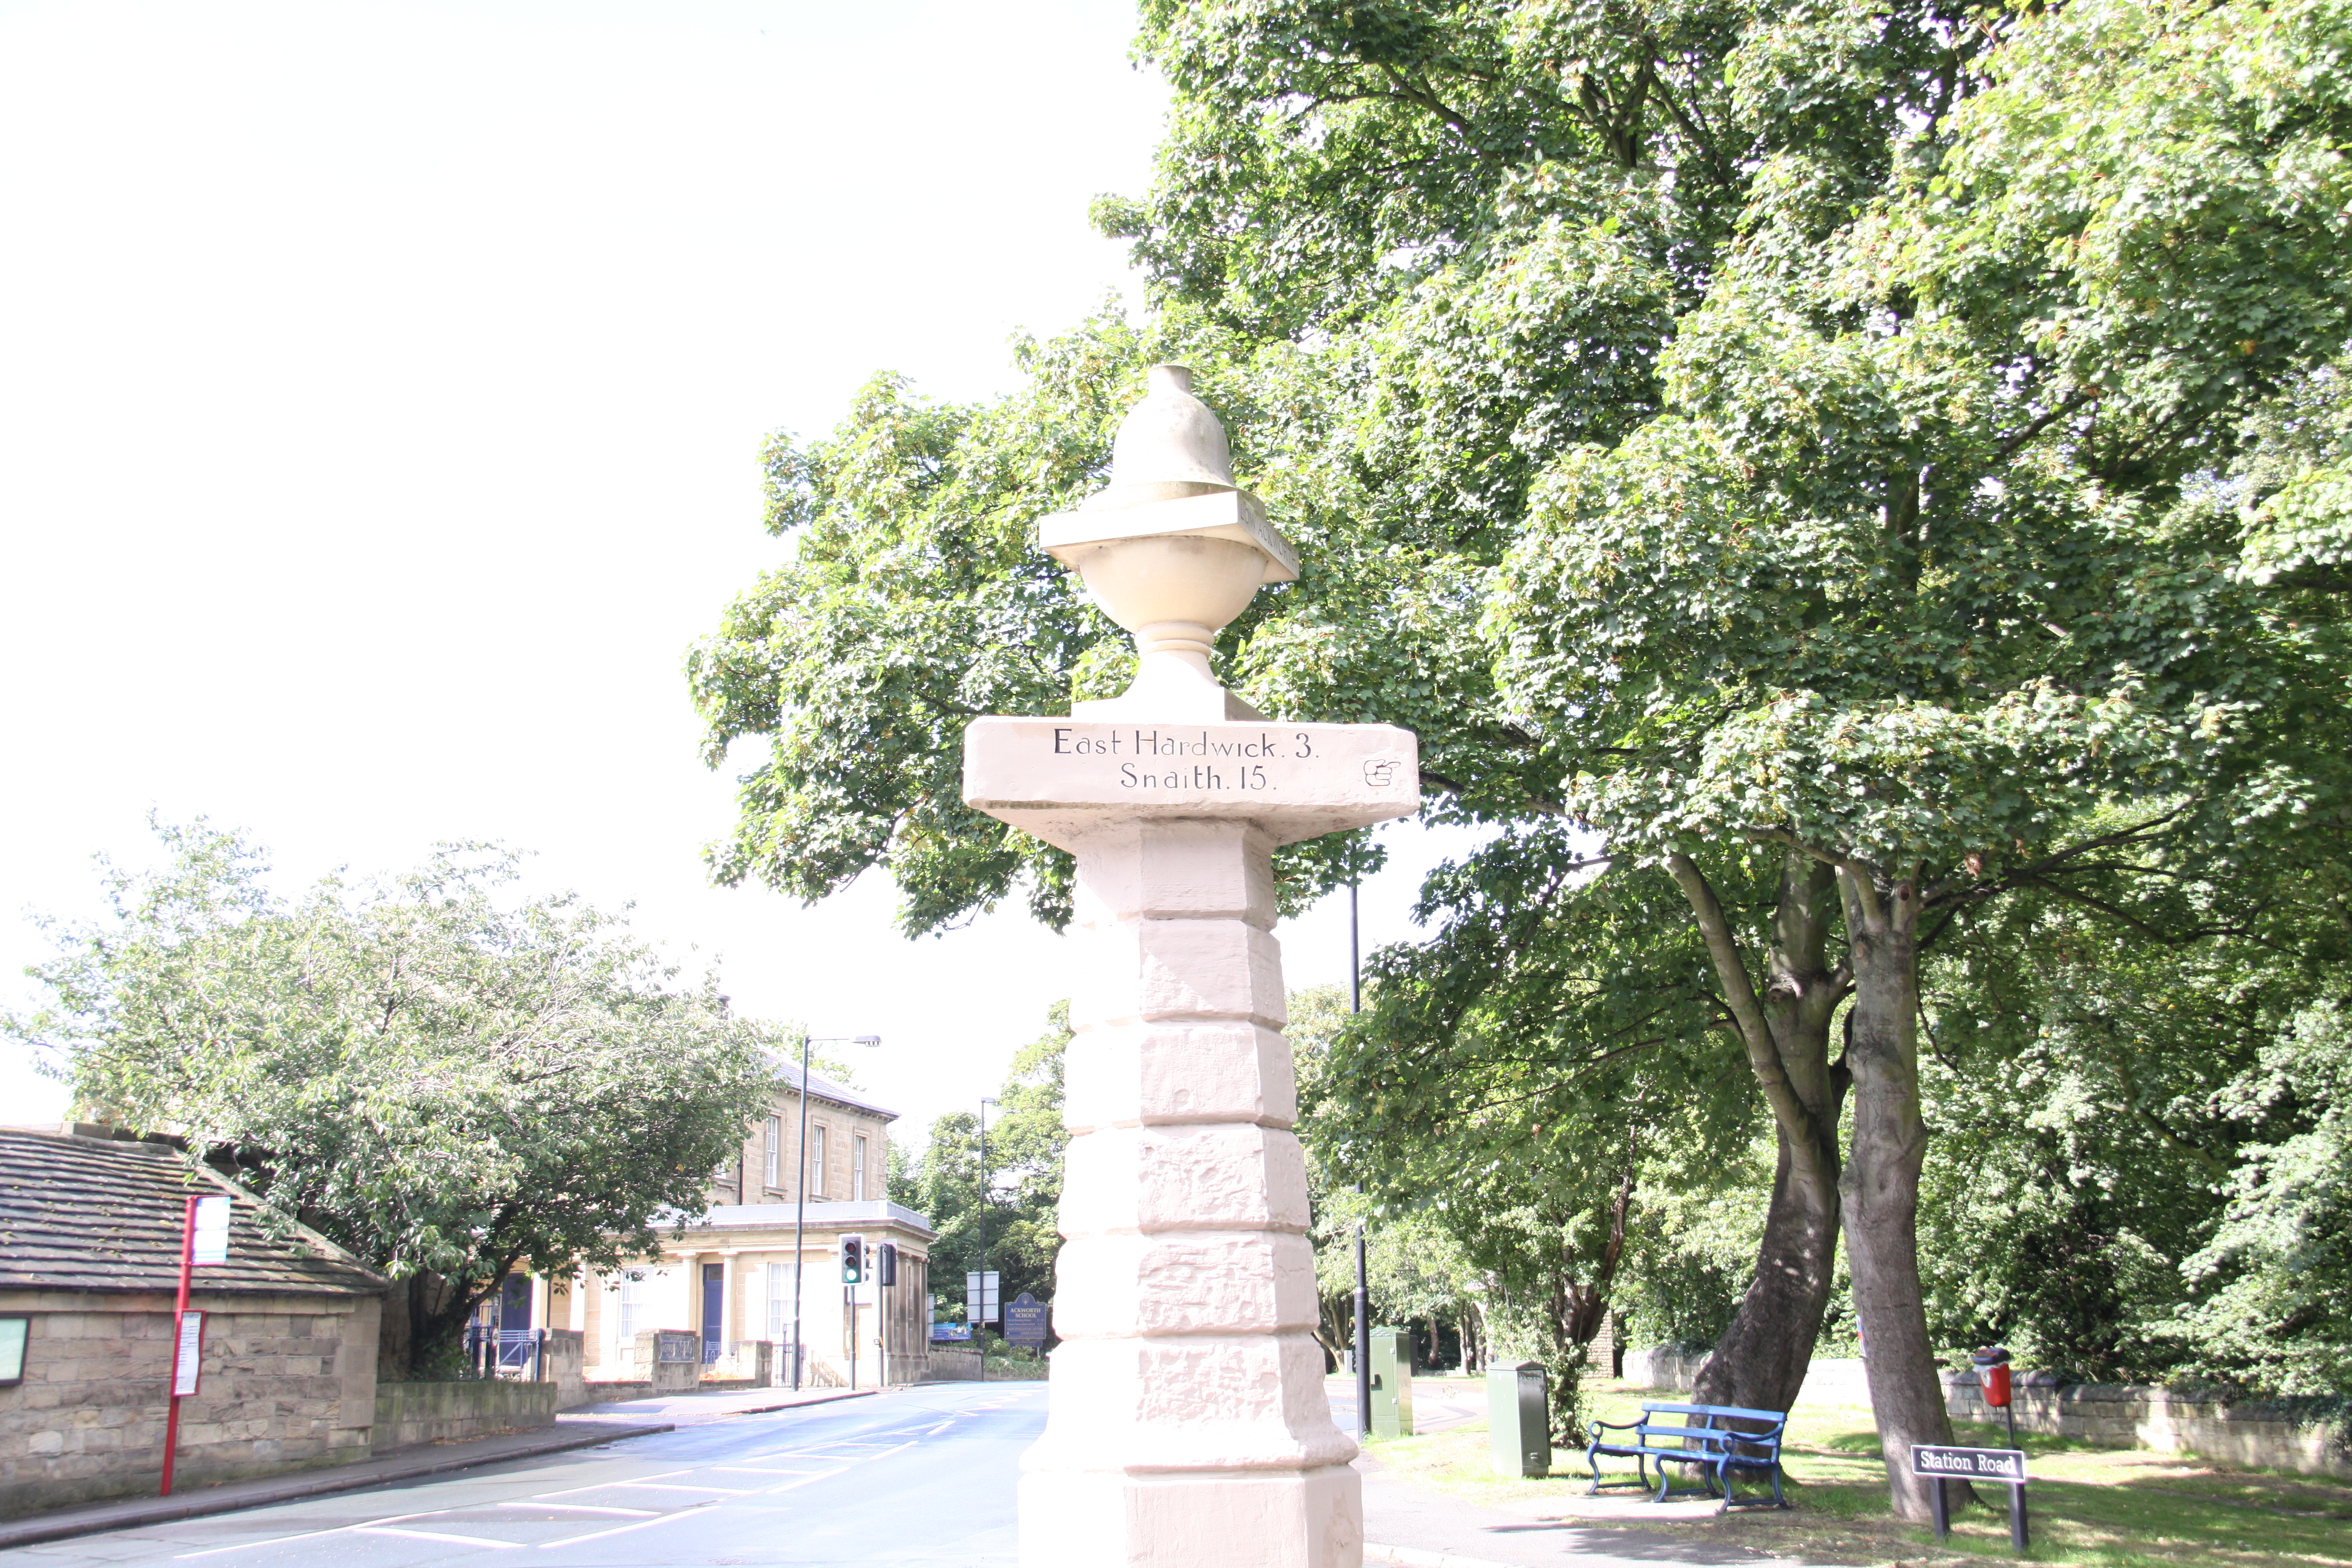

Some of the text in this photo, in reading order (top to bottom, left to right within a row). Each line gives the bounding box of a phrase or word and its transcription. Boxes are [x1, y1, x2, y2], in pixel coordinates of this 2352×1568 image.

[1240, 503, 1297, 569] LOW ACKWORTH
[1054, 728, 1122, 754] East
[1920, 1450, 2017, 1474] Station Road
